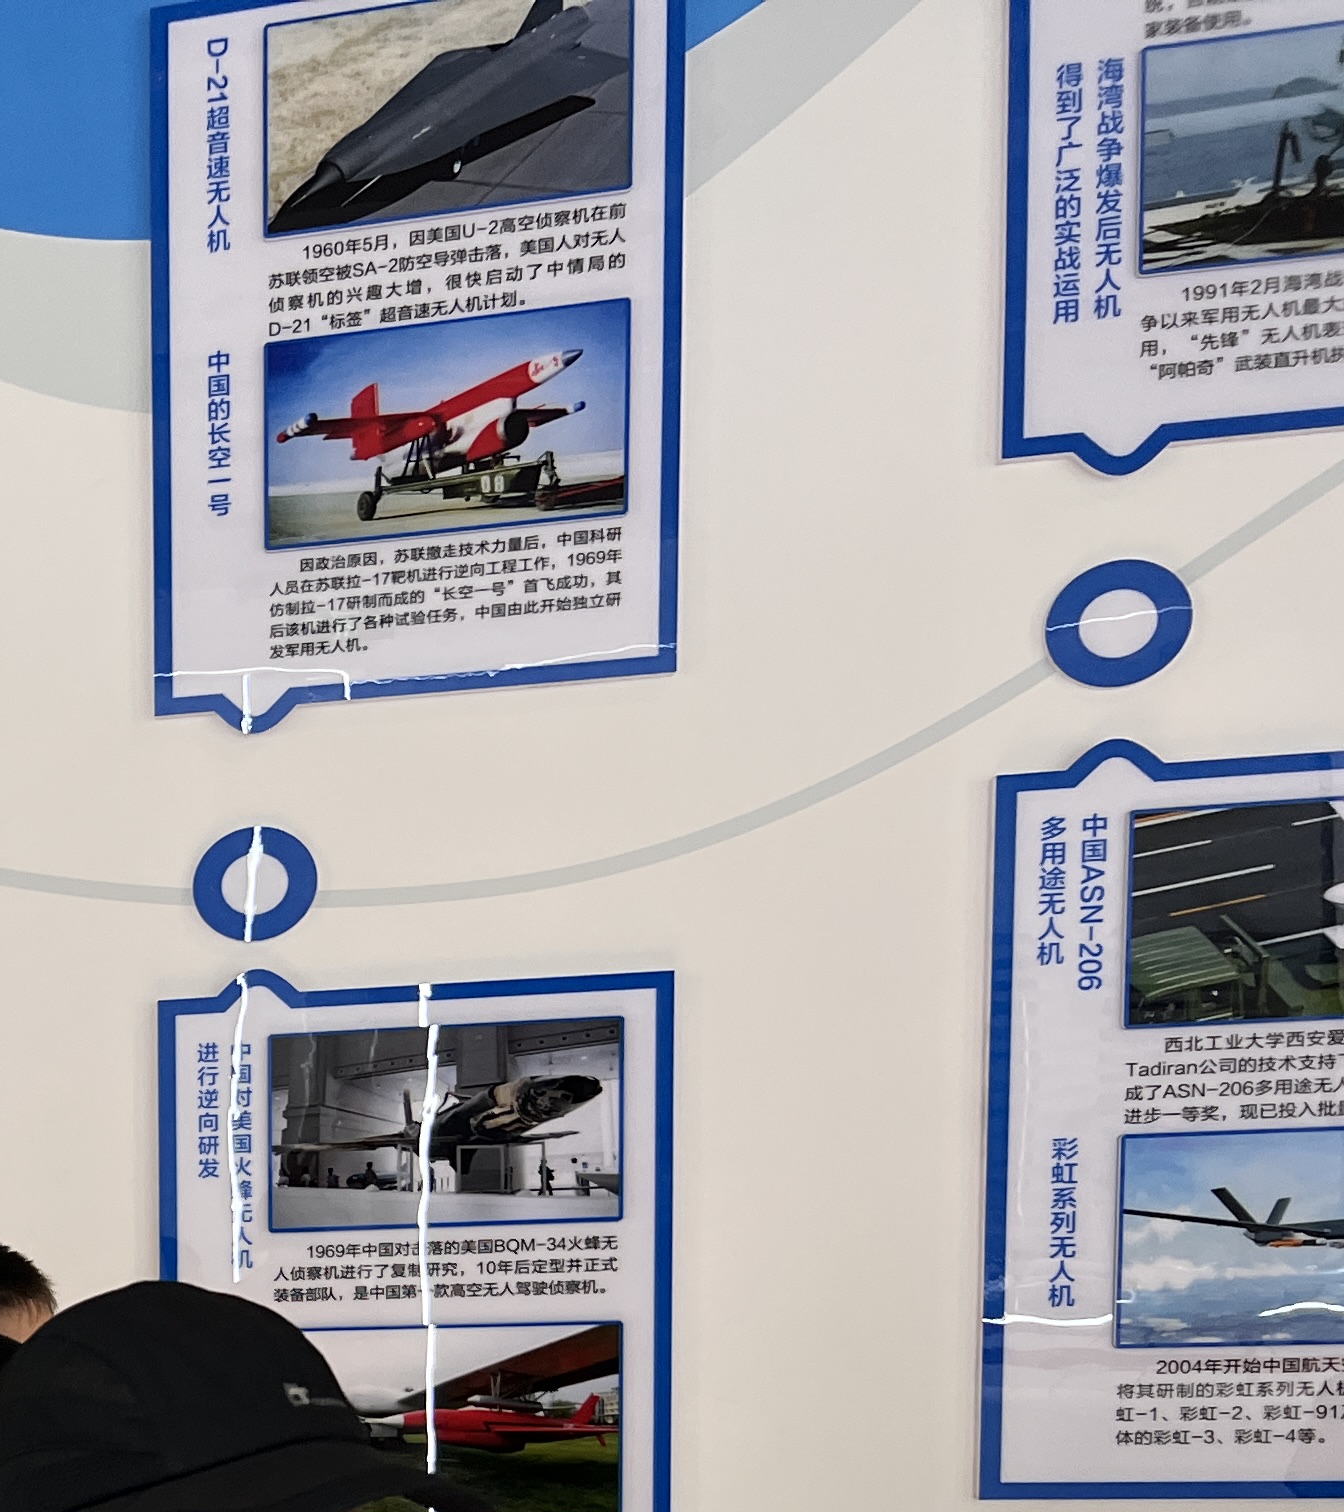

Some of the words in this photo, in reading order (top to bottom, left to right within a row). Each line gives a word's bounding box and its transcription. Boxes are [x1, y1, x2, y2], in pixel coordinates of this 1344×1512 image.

[206, 37, 231, 253] D-21超音速无人机
[1053, 63, 1084, 324] 得到了广泛的实战运用
[1094, 57, 1125, 319] 海湾战争爆发后无人机
[268, 228, 626, 290] 苏联领空被SA-2防空导弹击落，美国人对无人
[302, 202, 627, 260] 1960年5月，因美国U-2高空侦察机在前
[268, 253, 626, 313] 侦察机的兴趣大增，很快启动了中情局的
[268, 290, 527, 337] D-21“标签”超音速无人机计划。
[1140, 320, 1344, 358] 用，“先锋”无人机表
[1141, 295, 1344, 332] 争以来军用无人机最大
[207, 350, 231, 517] 中国的长空一号
[299, 525, 623, 573] 因政治原因，苏联撤走技术力量后，中国科研
[269, 592, 622, 639] 后该机进行了各种试验任务，中国由此开始独立研
[269, 639, 369, 660] 发军用无人机。
[1036, 816, 1066, 966] 多用途无人机
[1077, 813, 1107, 991] 中国ASN-206
[197, 1042, 220, 1179] 进行逆向研发
[1047, 1137, 1079, 1308] 彩虹系列无人机
[273, 1279, 606, 1302] 装备部队，是中国第一款高空无人驾驶侦察机。
[1115, 1428, 1327, 1446] 体的彩虹-3、彩虹-4等。
